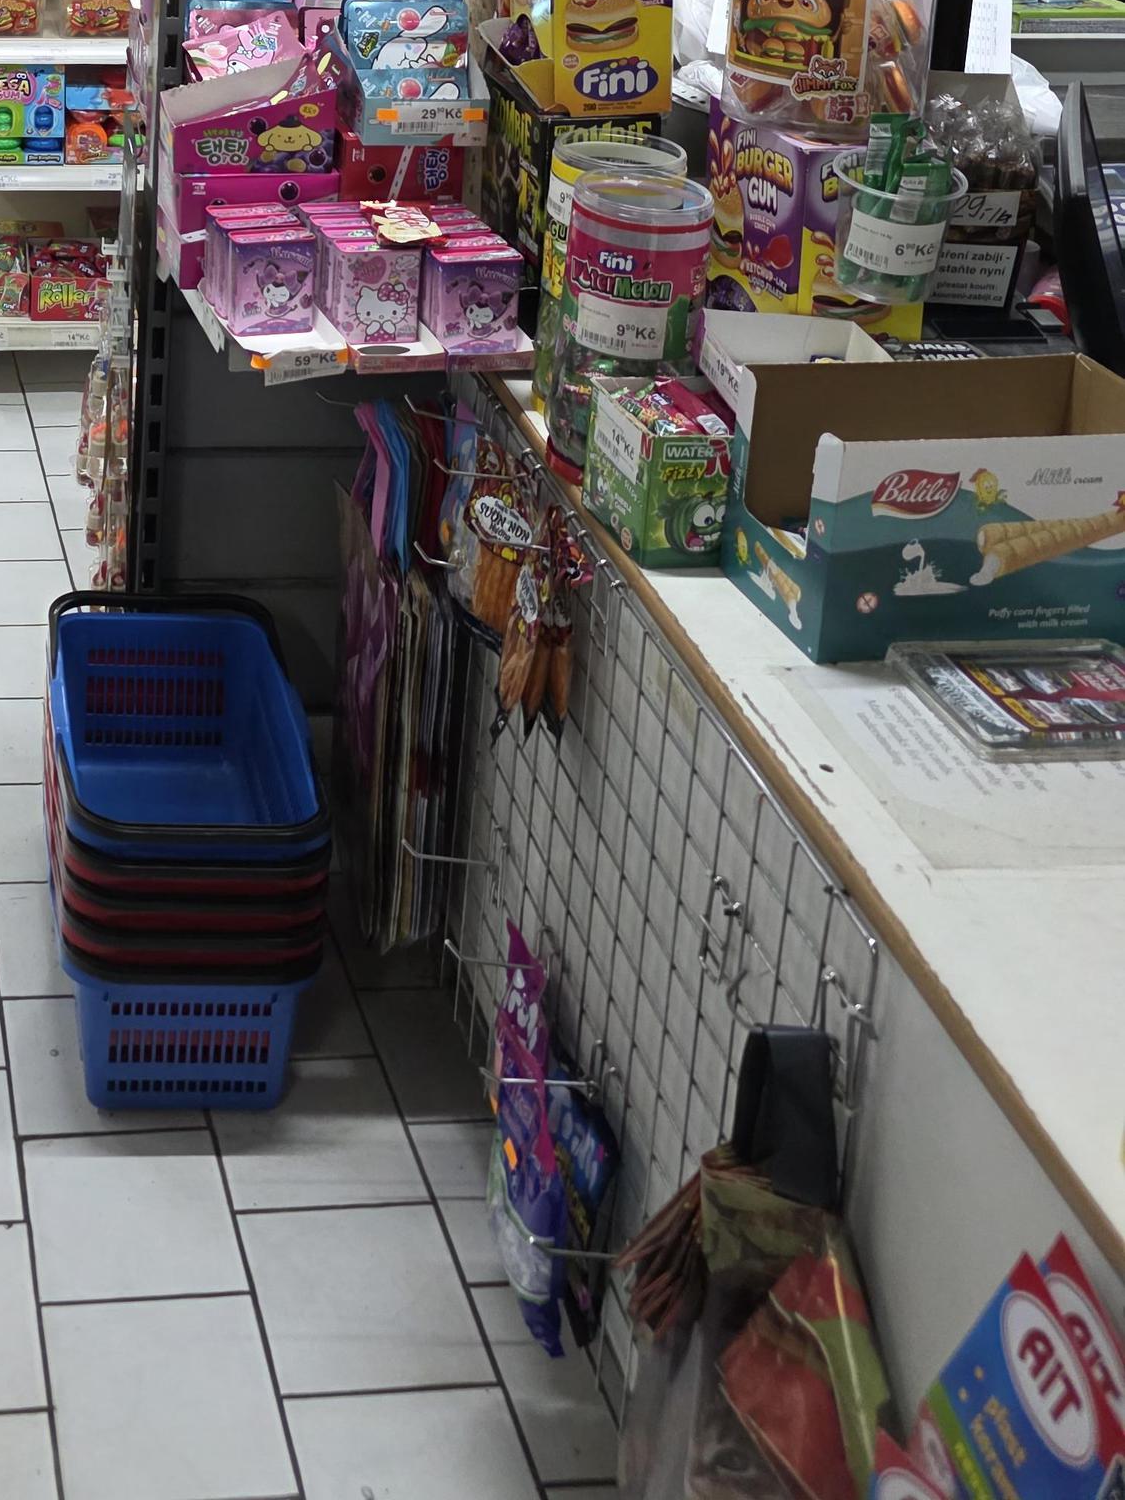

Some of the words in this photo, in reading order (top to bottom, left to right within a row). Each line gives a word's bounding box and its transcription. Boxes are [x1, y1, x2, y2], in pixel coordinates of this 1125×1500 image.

[582, 60, 648, 97] Fini
[737, 129, 756, 151] FINI
[736, 148, 794, 193] BURGER
[747, 176, 778, 212] GUM
[551, 220, 567, 240] GU
[599, 250, 634, 271] Fini
[38, 281, 93, 312] Roller
[666, 445, 714, 458] WATER
[1073, 476, 1103, 485] cream
[988, 607, 1011, 619] Puffy
[1013, 608, 1033, 617] corn
[1035, 606, 1065, 618] fingers
[1066, 604, 1090, 615] filled
[1018, 618, 1037, 628] with
[1039, 618, 1059, 627] milk
[1060, 618, 1088, 627] cream
[1018, 1327, 1082, 1423] AIT
